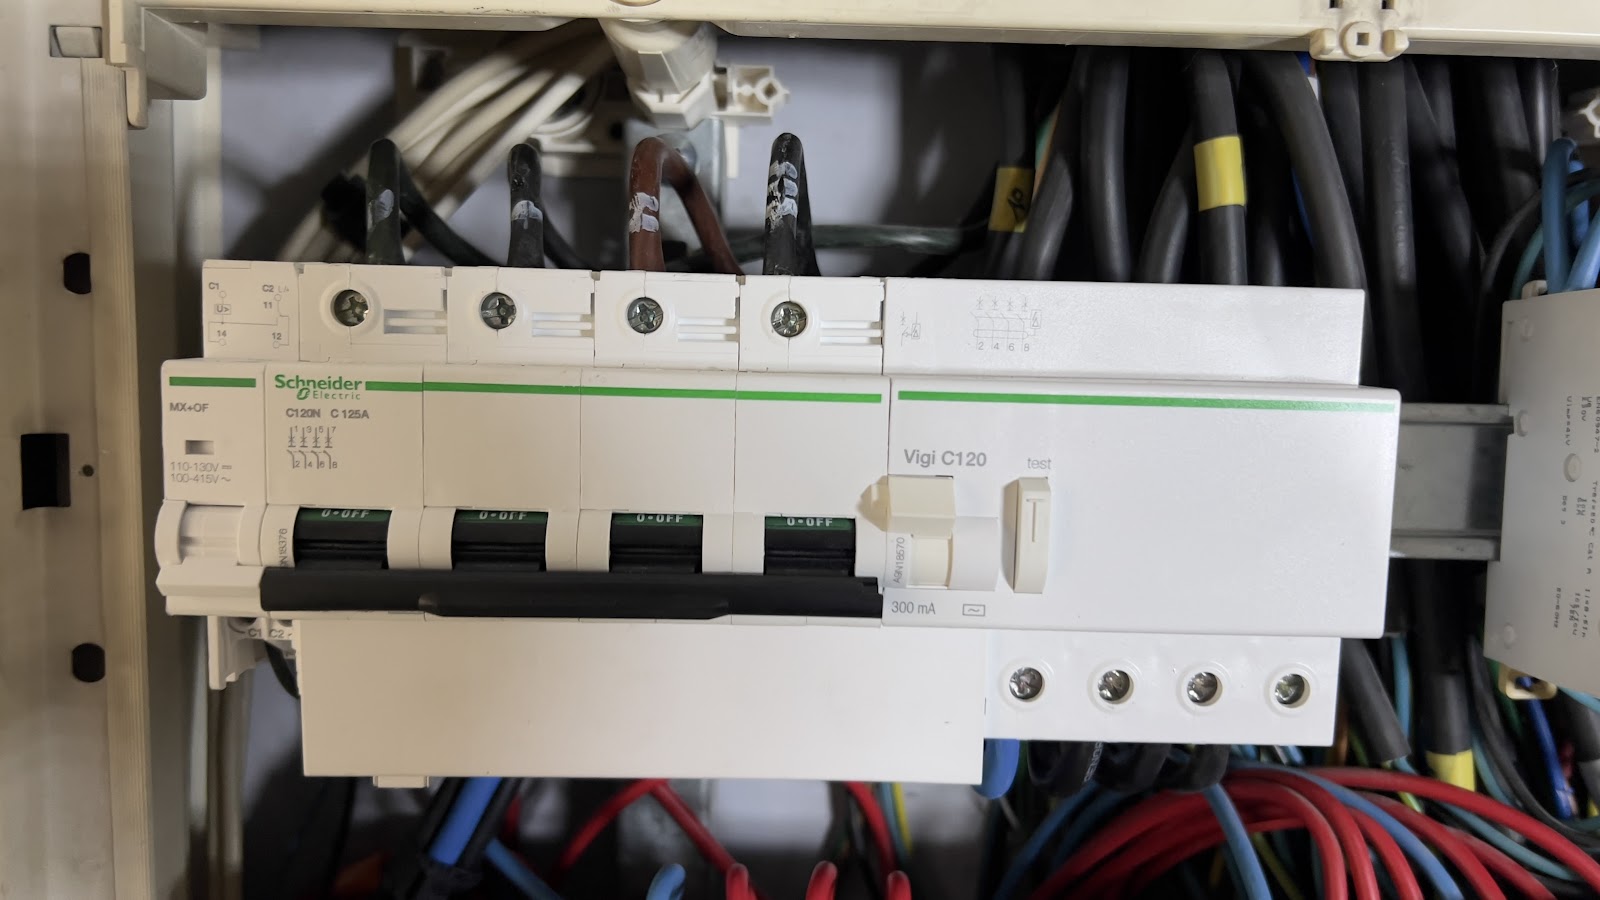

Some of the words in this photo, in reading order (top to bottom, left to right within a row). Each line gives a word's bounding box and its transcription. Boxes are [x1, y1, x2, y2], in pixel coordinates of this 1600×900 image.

[208, 281, 220, 291] C1
[262, 284, 274, 293] C2
[263, 301, 273, 310] 11
[217, 329, 227, 338] 14
[271, 332, 282, 341] 12
[978, 341, 985, 351] 2
[993, 342, 1000, 350] 4
[1008, 342, 1015, 352] 6
[1023, 342, 1030, 352] 8
[274, 374, 363, 391] Schneider
[312, 390, 361, 400] Electric
[169, 402, 209, 413] MX+OF
[285, 408, 321, 418] C120N
[330, 408, 339, 419] C
[341, 409, 370, 419] 125A
[903, 449, 936, 468] Vigi
[941, 450, 987, 467] C120
[1027, 457, 1052, 470] test
[170, 461, 220, 473] 110-130V
[170, 473, 220, 485] 100-415V
[891, 601, 914, 614] 300
[917, 602, 936, 614] mA
[248, 627, 262, 638] C1
[269, 629, 284, 639] C2
